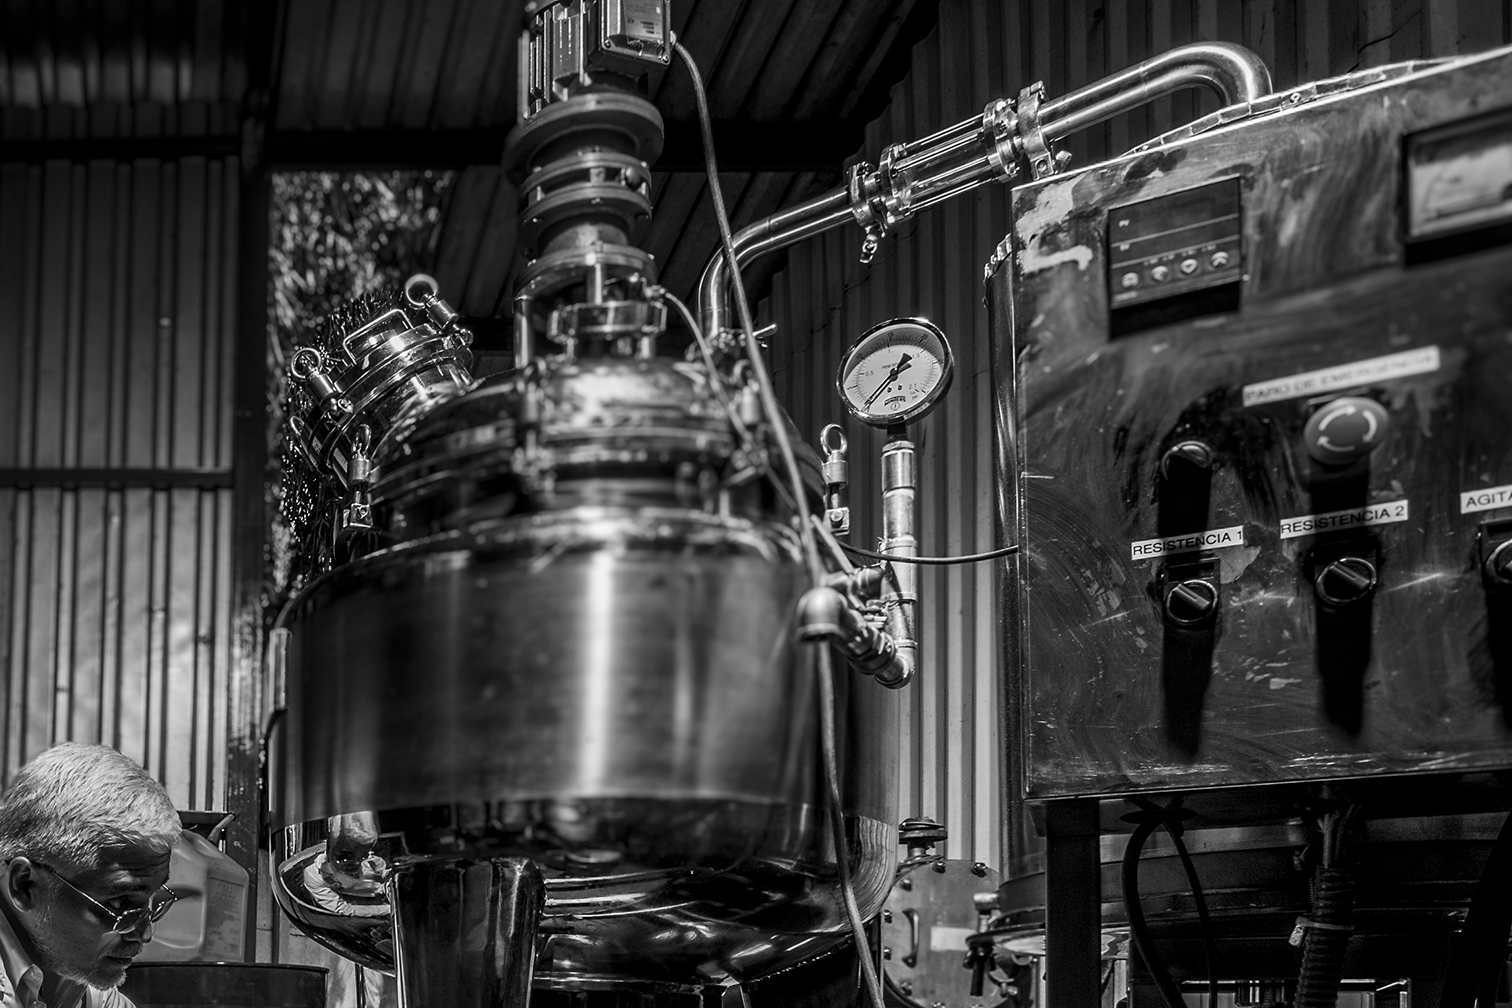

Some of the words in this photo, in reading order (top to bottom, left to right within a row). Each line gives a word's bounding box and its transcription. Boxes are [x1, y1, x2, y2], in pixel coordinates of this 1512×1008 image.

[1280, 509, 1384, 534] RESISTENCIA
[1394, 505, 1405, 517] 2
[1132, 531, 1232, 556] RESISTENCIA
